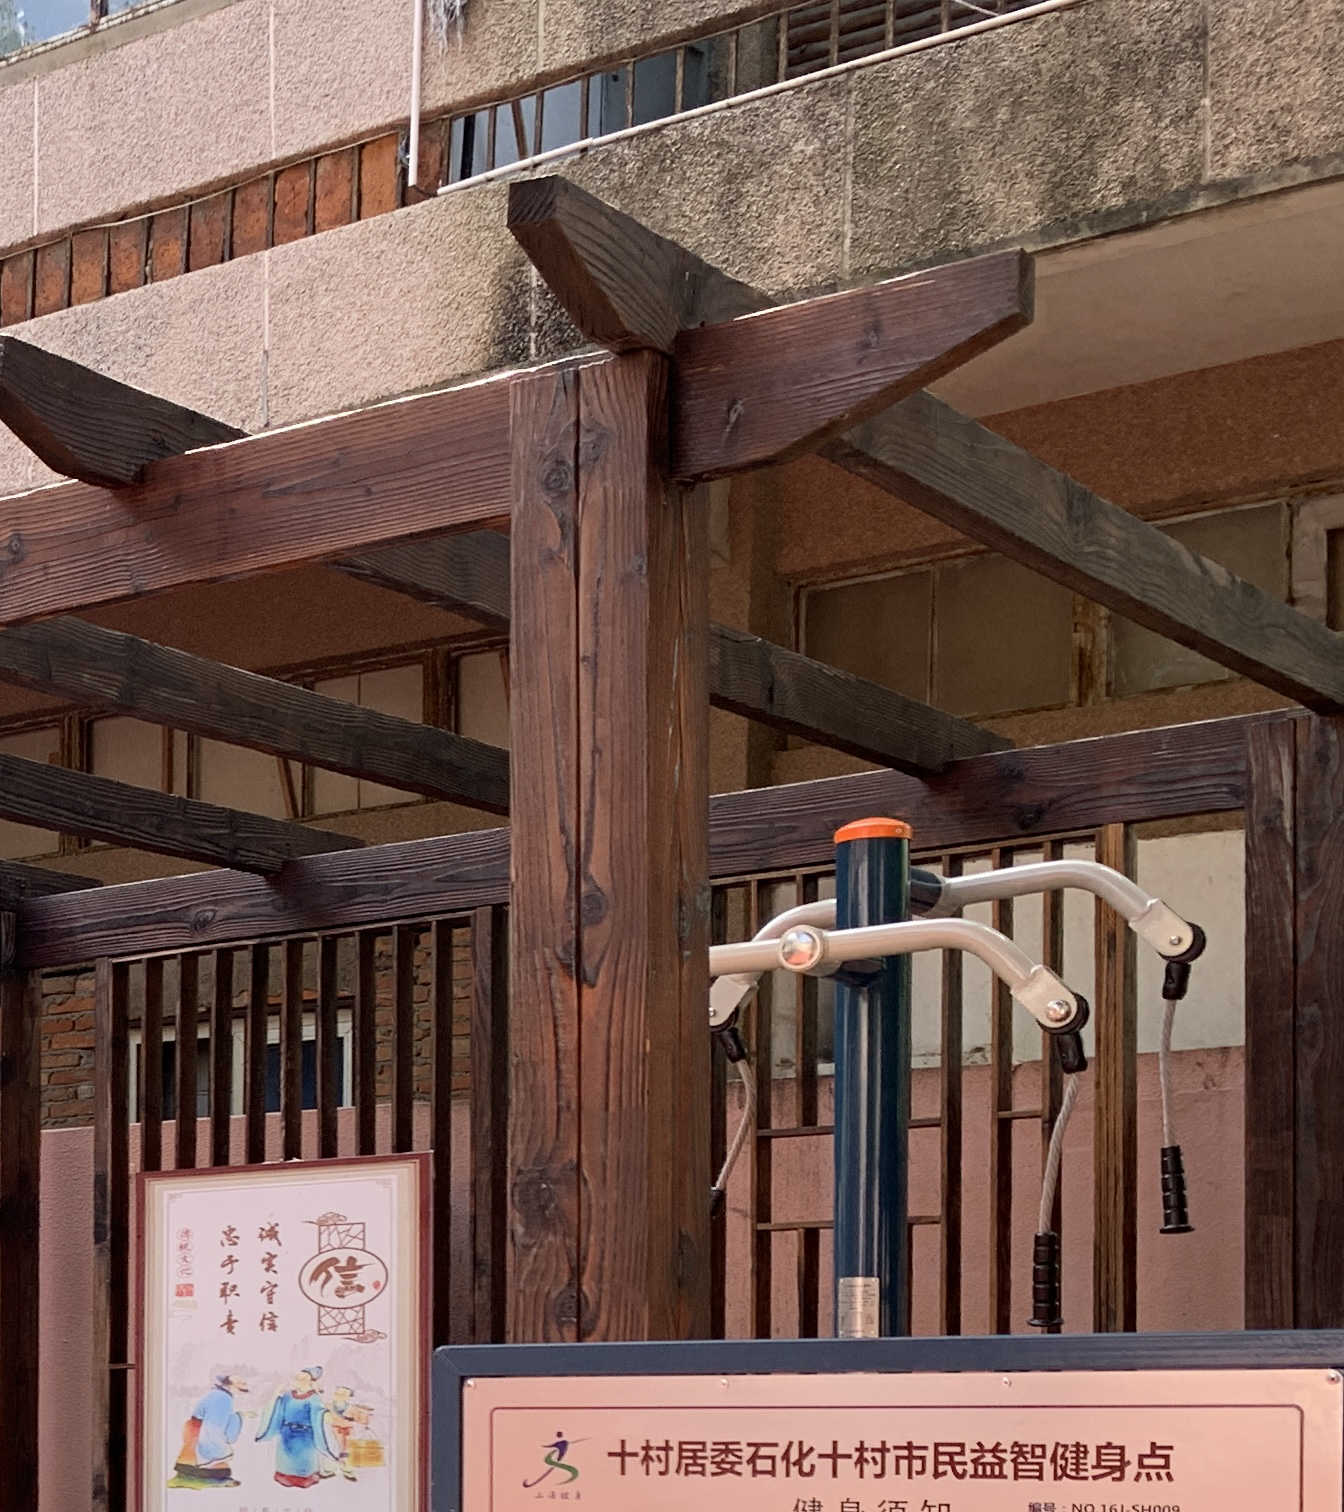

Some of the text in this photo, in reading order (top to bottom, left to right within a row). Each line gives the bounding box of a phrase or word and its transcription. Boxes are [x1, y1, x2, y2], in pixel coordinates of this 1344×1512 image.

[310, 1255, 375, 1298] 信
[608, 1439, 1174, 1482] 十村居委石化十村市民益智健身点
